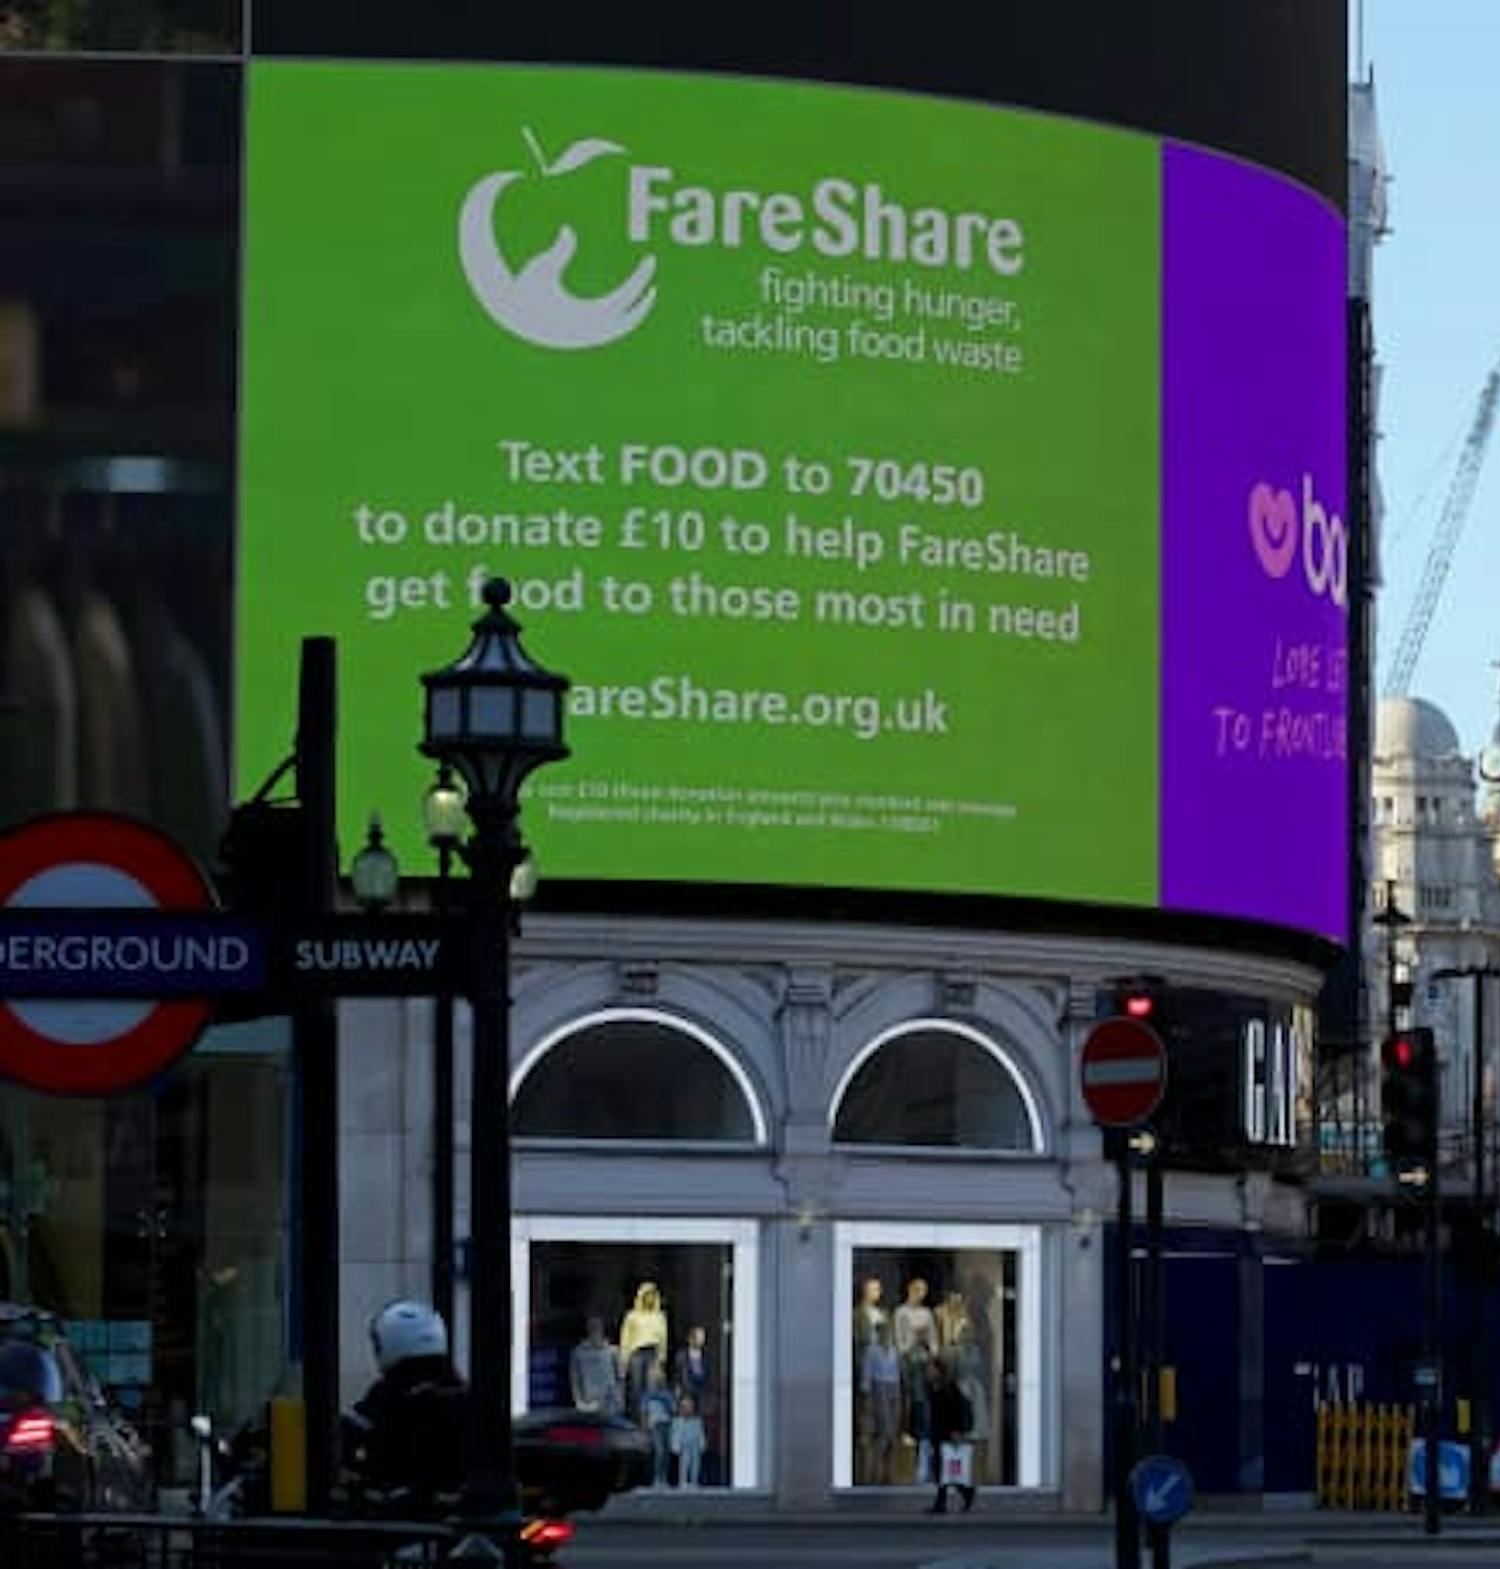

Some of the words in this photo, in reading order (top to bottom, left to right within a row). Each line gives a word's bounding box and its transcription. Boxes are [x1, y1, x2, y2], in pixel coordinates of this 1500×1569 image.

[627, 165, 1025, 276] FareShare
[760, 267, 895, 322] fighting
[903, 277, 1023, 331] hunger,
[700, 315, 839, 362] tackling
[846, 321, 925, 363] food
[933, 338, 1025, 373] waste
[499, 441, 606, 485] Text
[620, 443, 768, 491] FOOD
[782, 457, 834, 497] to
[847, 458, 985, 508] 70450
[354, 506, 407, 545] to
[422, 500, 605, 550] donate
[619, 508, 706, 551] £10
[719, 516, 771, 557] to
[784, 514, 886, 567] help
[897, 522, 1091, 584] FareShare
[366, 574, 451, 621] get
[602, 576, 654, 614] to
[669, 572, 802, 622] those
[814, 585, 927, 631] most
[938, 587, 976, 632] in
[989, 600, 1081, 643] need
[568, 676, 949, 740] areShare.org.uk
[1212, 706, 1251, 757] TO
[0, 935, 250, 971] ERGROUND
[295, 939, 441, 972] SUBWAY
